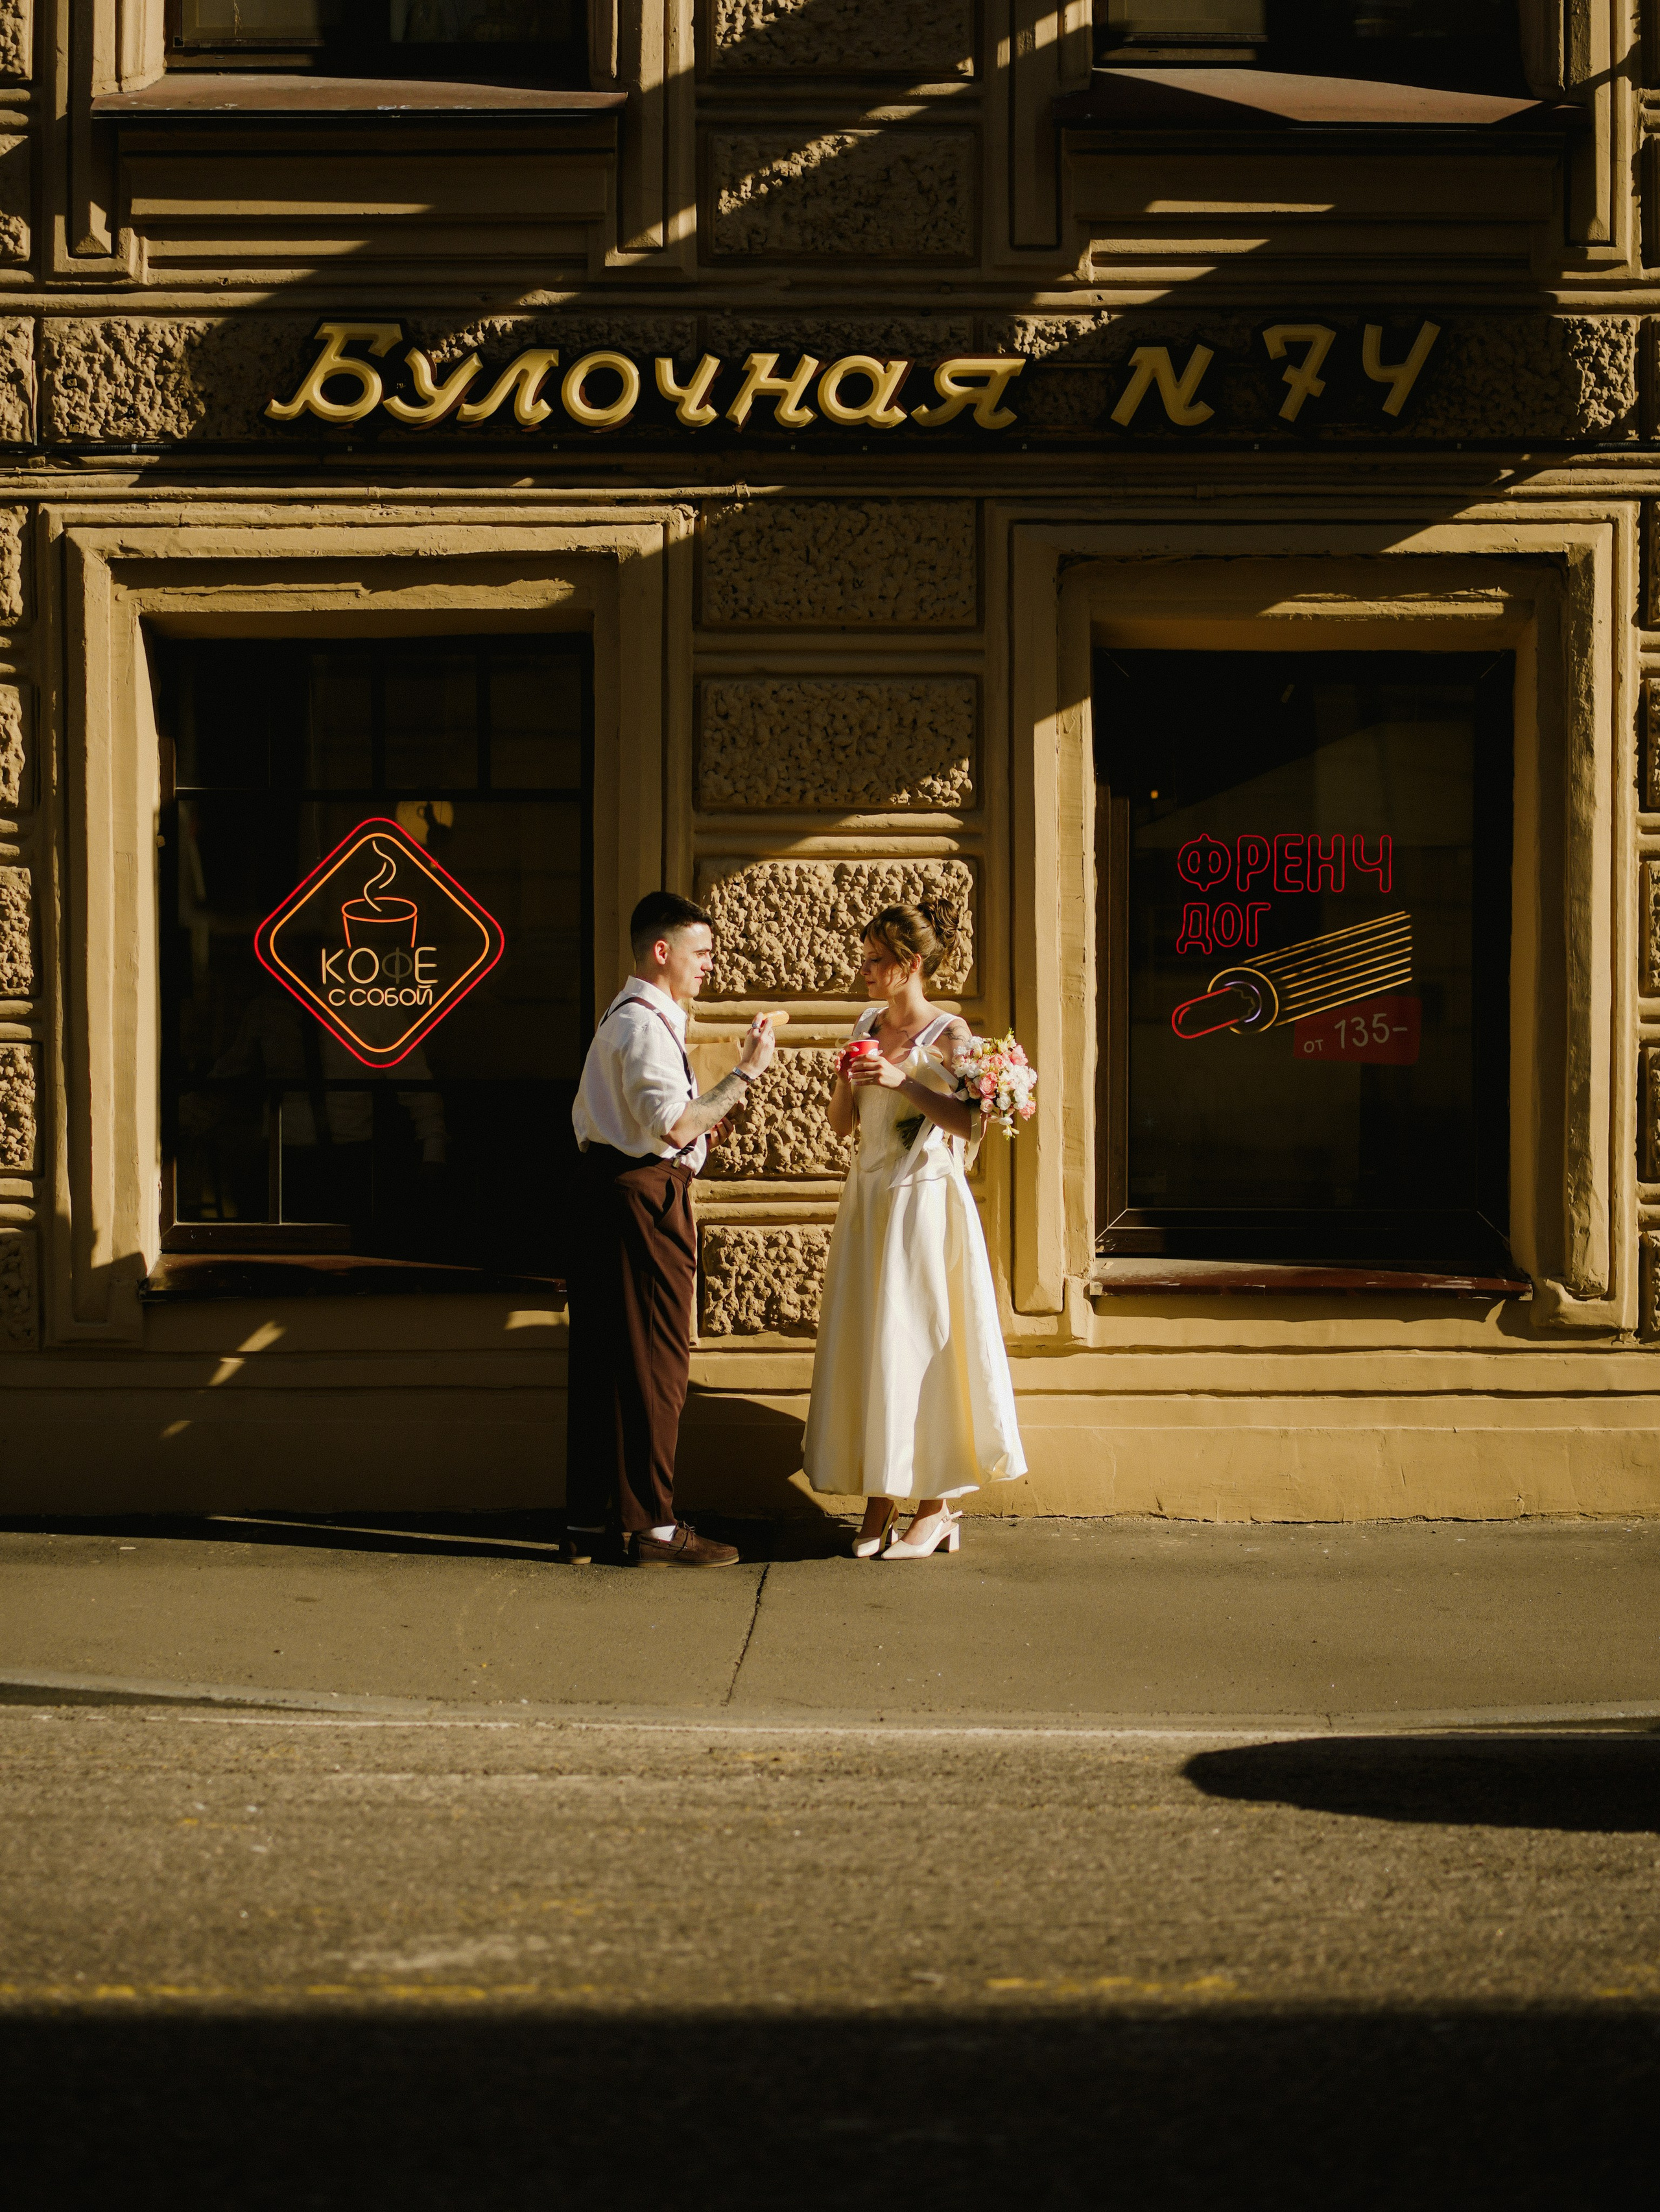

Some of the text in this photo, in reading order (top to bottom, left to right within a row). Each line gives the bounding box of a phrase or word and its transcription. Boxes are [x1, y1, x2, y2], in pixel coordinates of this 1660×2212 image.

[263, 322, 1026, 431] Булочная
[1177, 833, 1393, 894] ФРЕНЧ
[1176, 902, 1272, 955] ДОГ
[321, 947, 439, 985] КОФЕ
